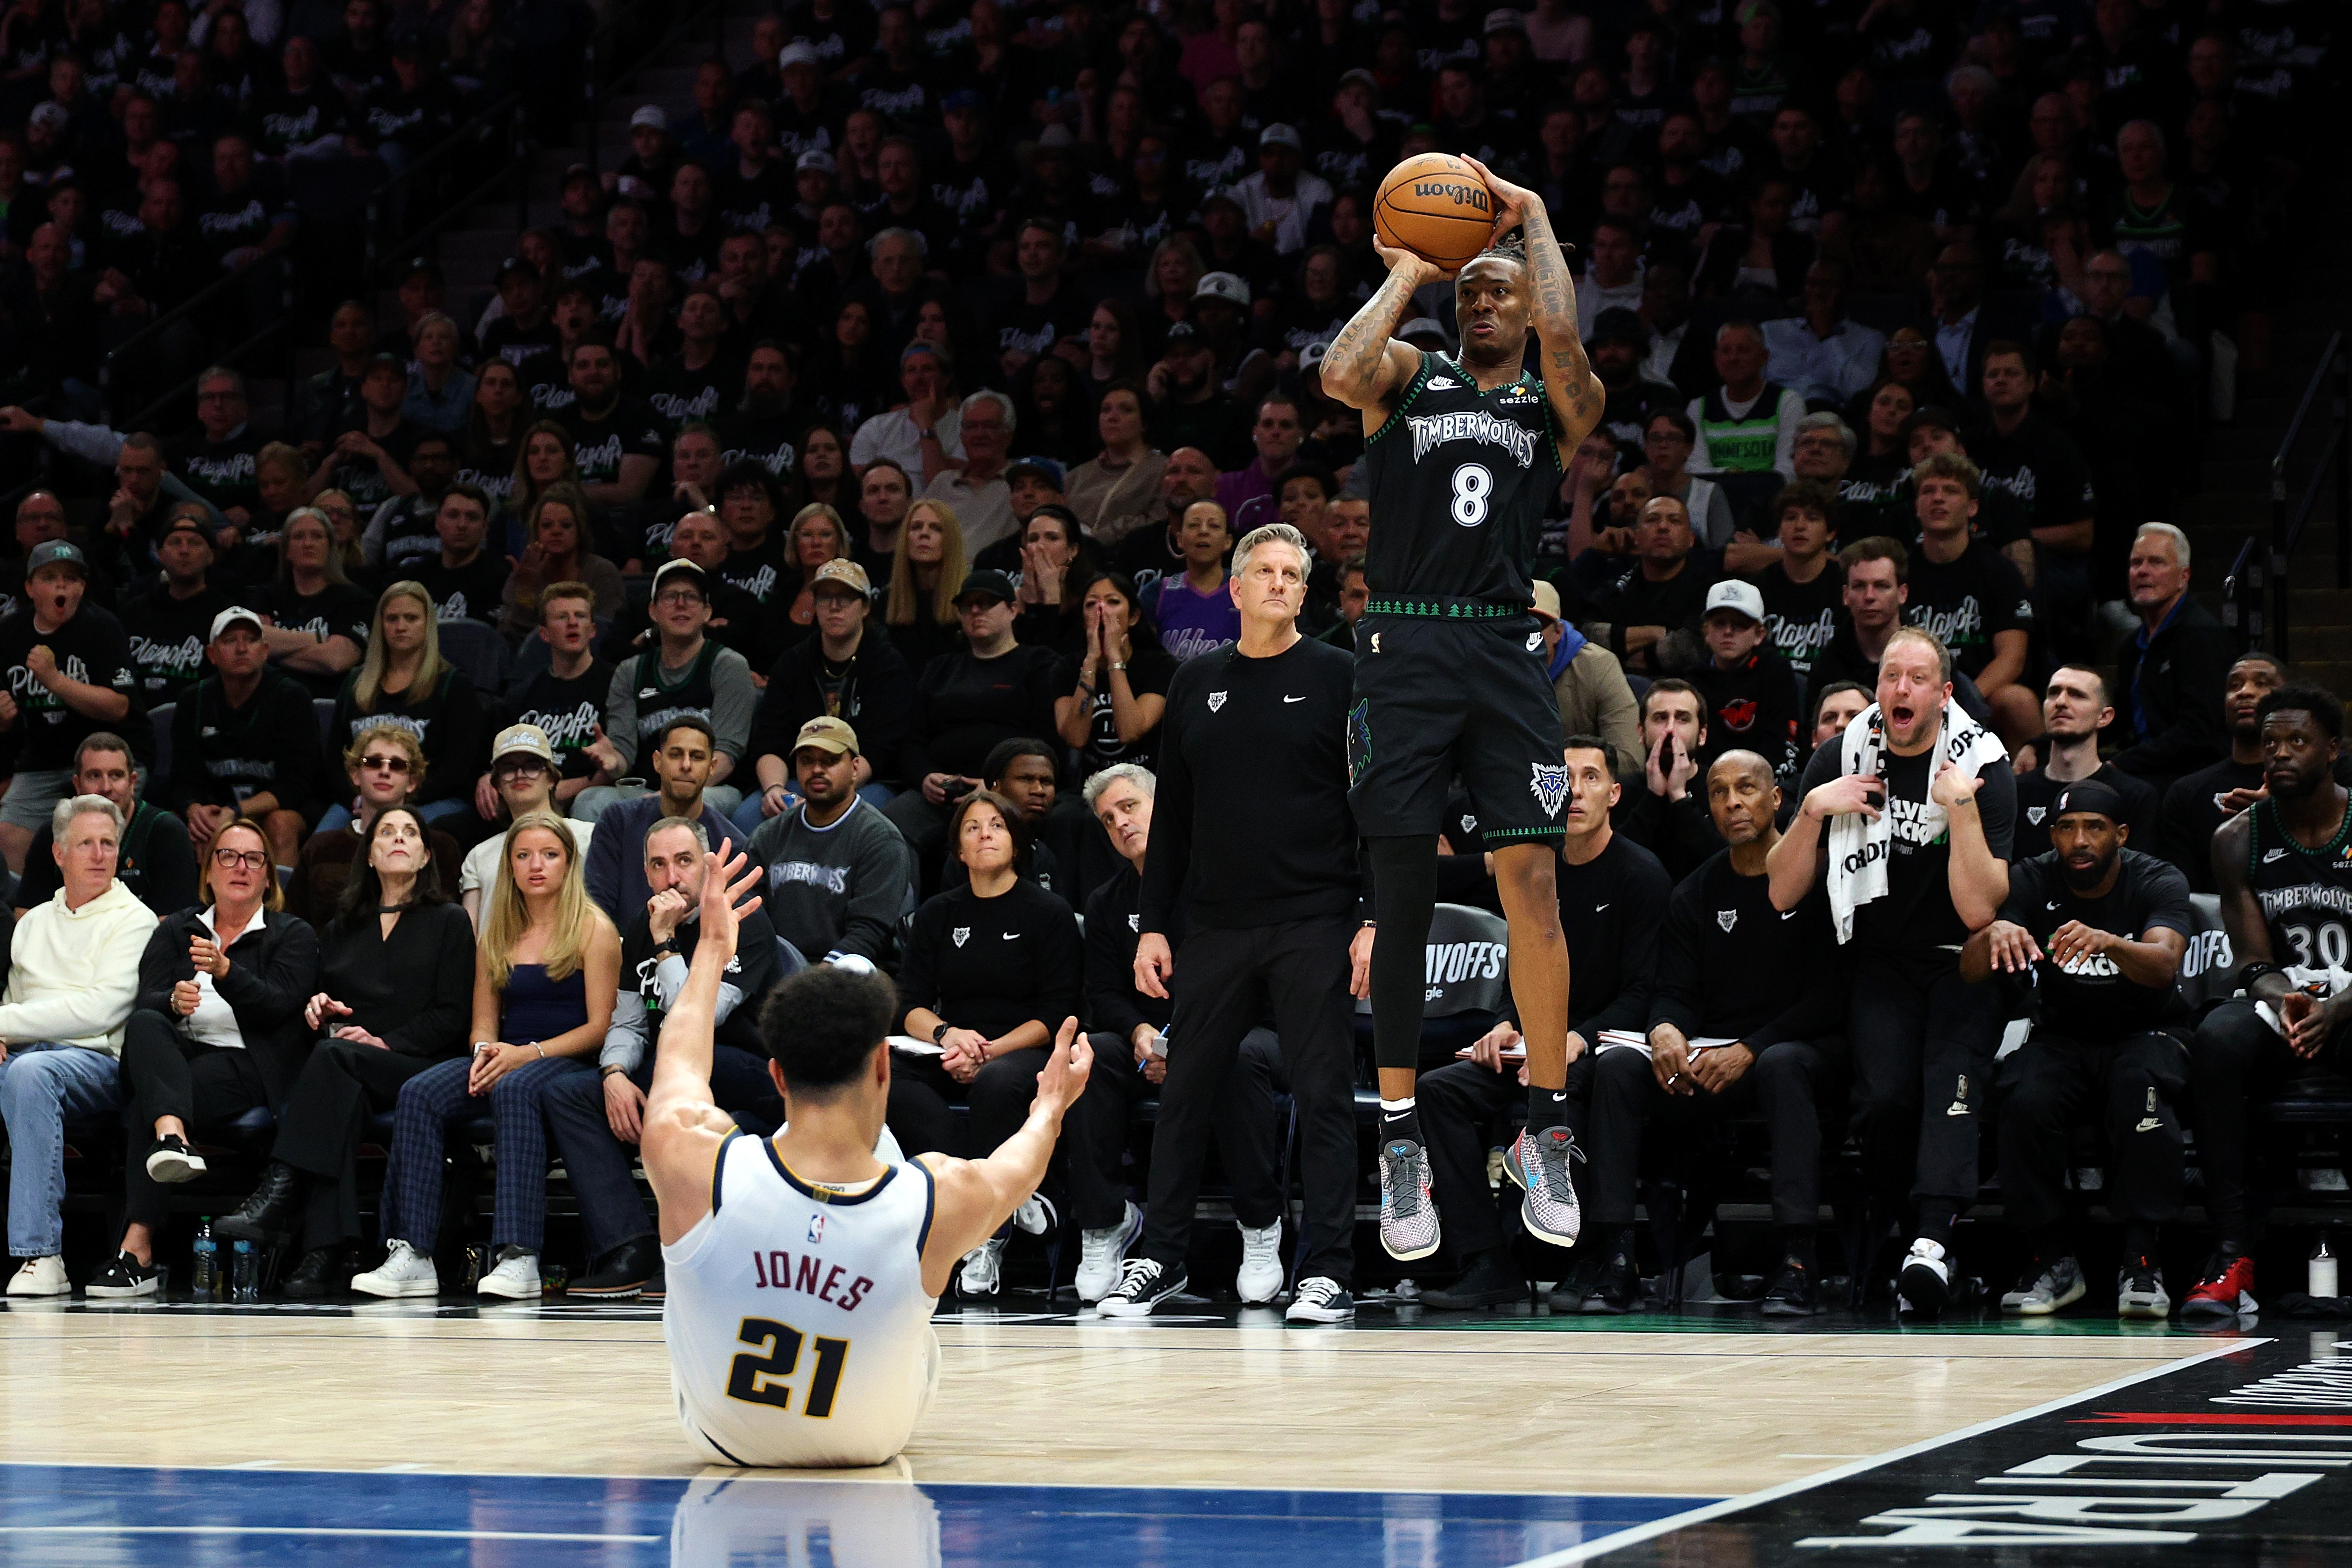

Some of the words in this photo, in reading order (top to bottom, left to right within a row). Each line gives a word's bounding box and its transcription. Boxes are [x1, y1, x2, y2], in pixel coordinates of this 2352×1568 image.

[1414, 182, 1489, 214] Wilson
[1432, 375, 1455, 387] NIKE
[1499, 394, 1539, 405] sezzle
[1405, 409, 1545, 469] TIMBERWOLVES
[1451, 462, 1493, 527] 8
[1529, 632, 1541, 644] NIKE
[129, 635, 205, 674] Playoffs
[2267, 848, 2285, 857] NIKE
[2280, 920, 2350, 969] 30
[1952, 1101, 1968, 1111] NIKE
[2141, 1118, 2159, 1127] NIKE
[754, 1250, 874, 1312] JONES
[725, 1316, 851, 1420] 21
